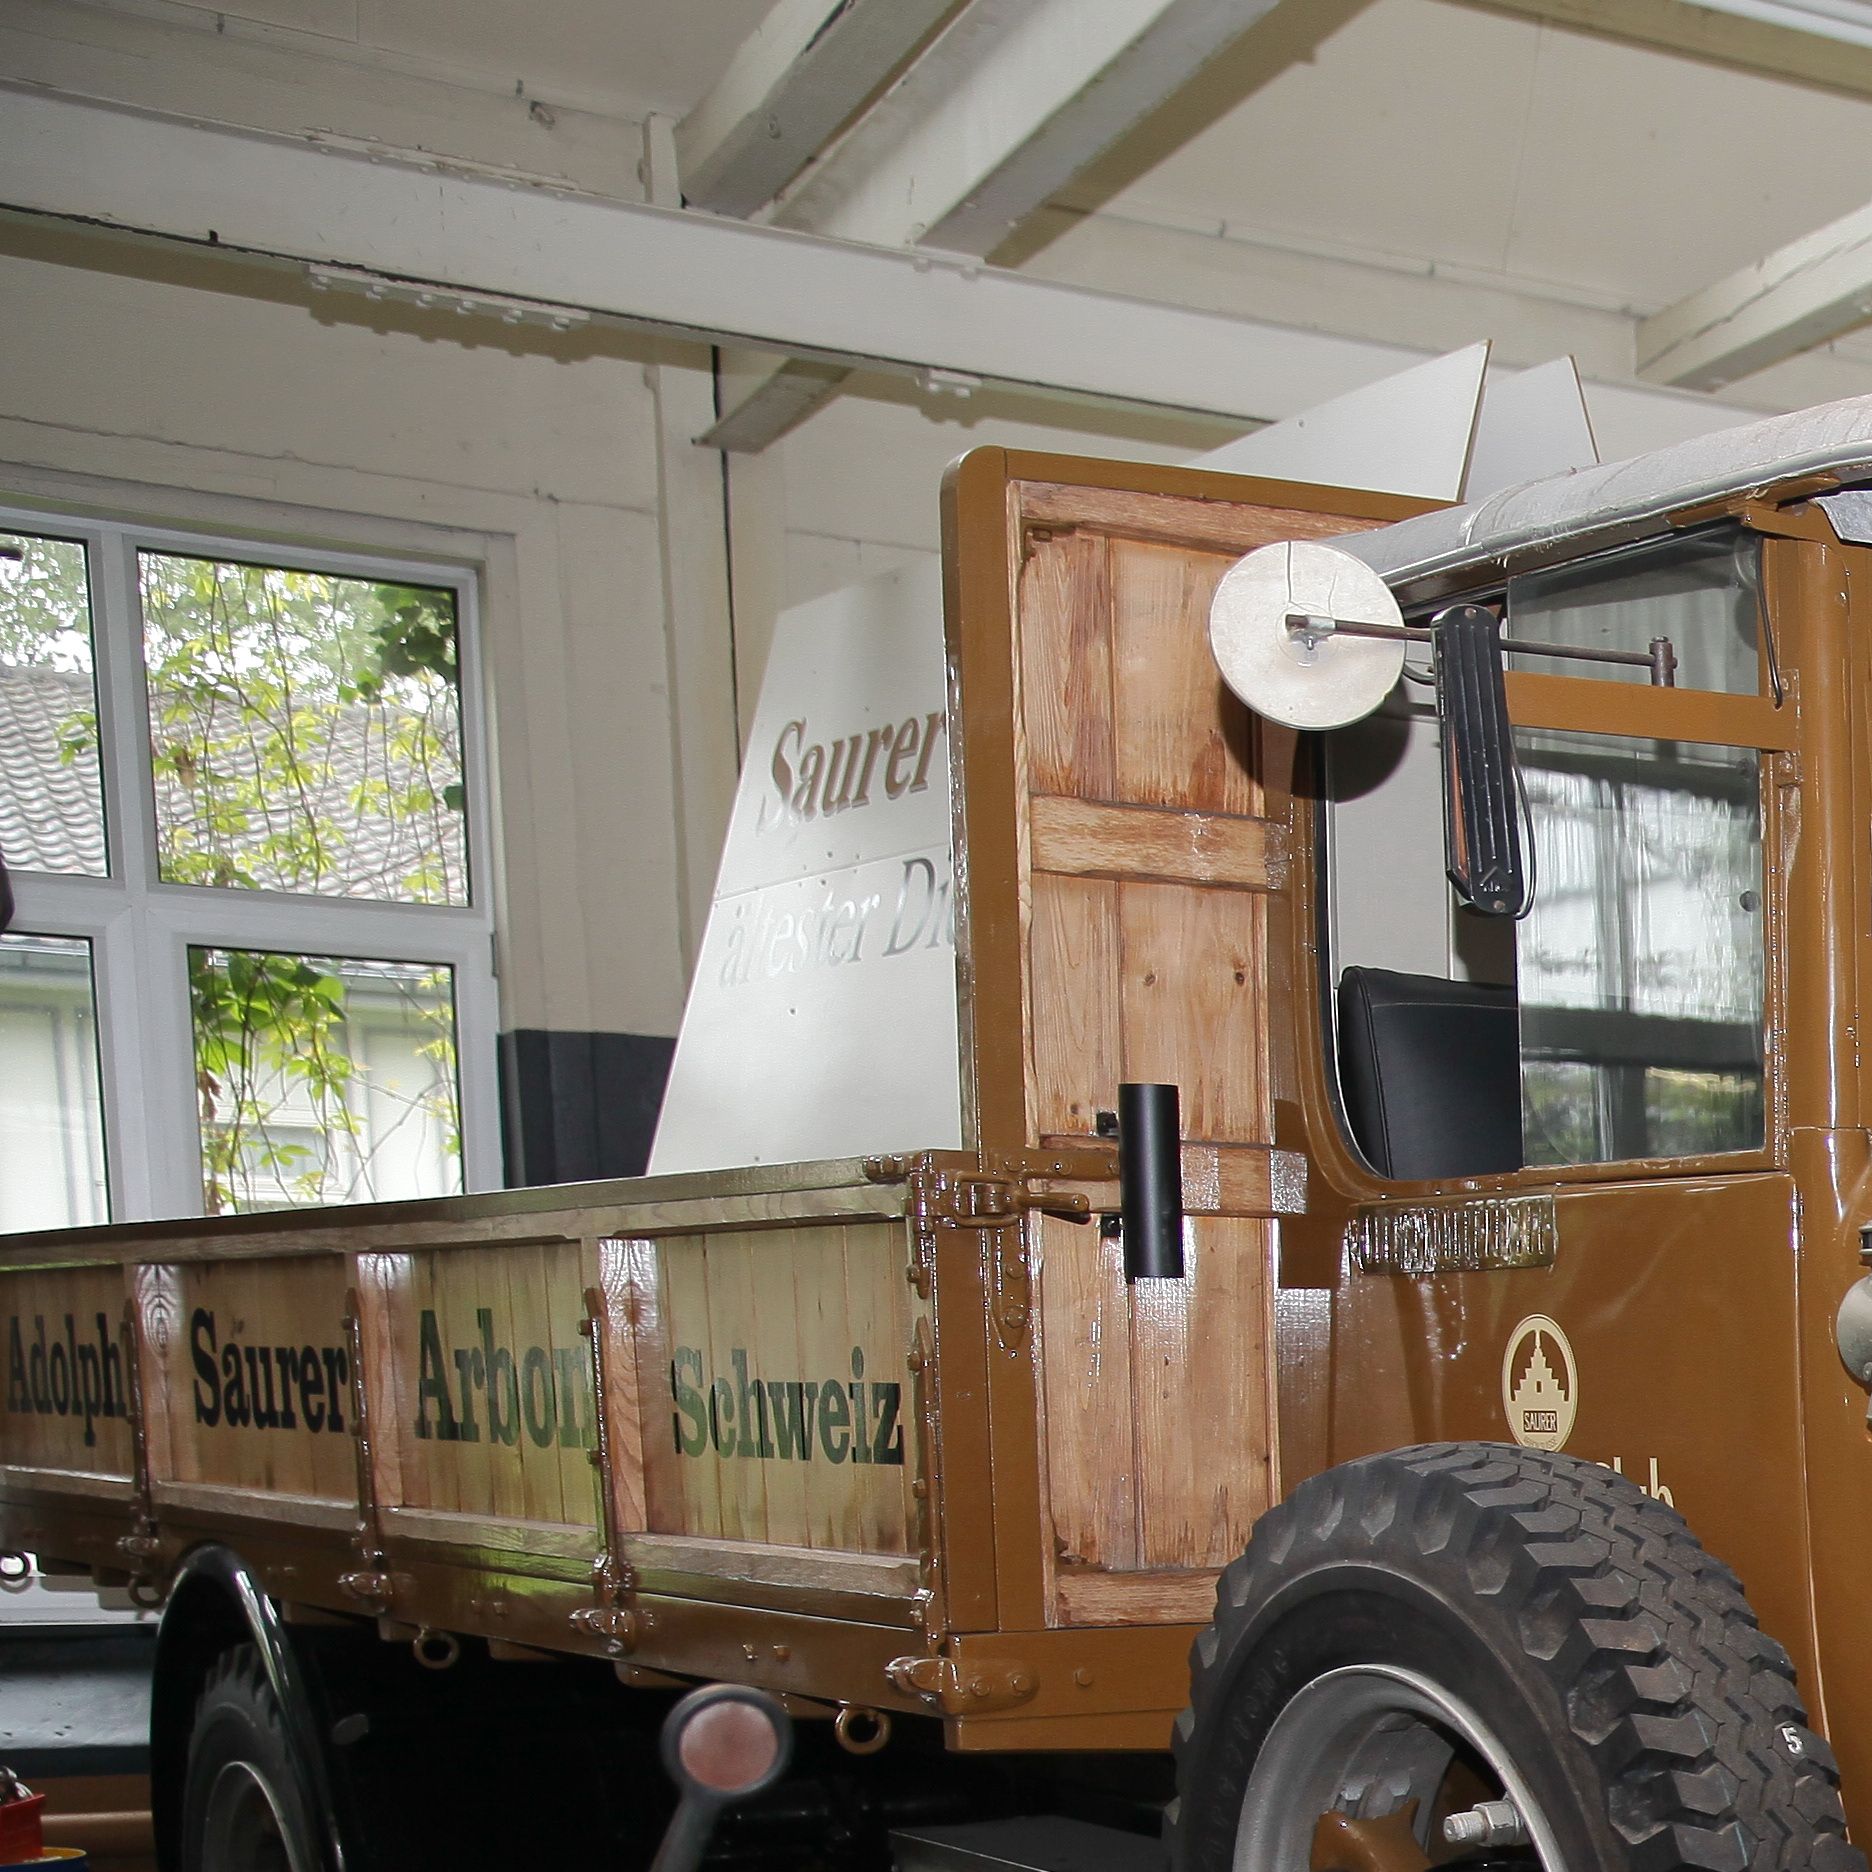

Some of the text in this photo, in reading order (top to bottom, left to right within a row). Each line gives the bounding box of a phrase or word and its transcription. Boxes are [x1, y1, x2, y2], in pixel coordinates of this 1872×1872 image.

[756, 711, 946, 840] Saurer
[8, 1307, 905, 1467] Adolph Saurer Arbon Schweiz
[1523, 1411, 1557, 1432] SAURER
[1781, 1726, 1803, 1754] 5
